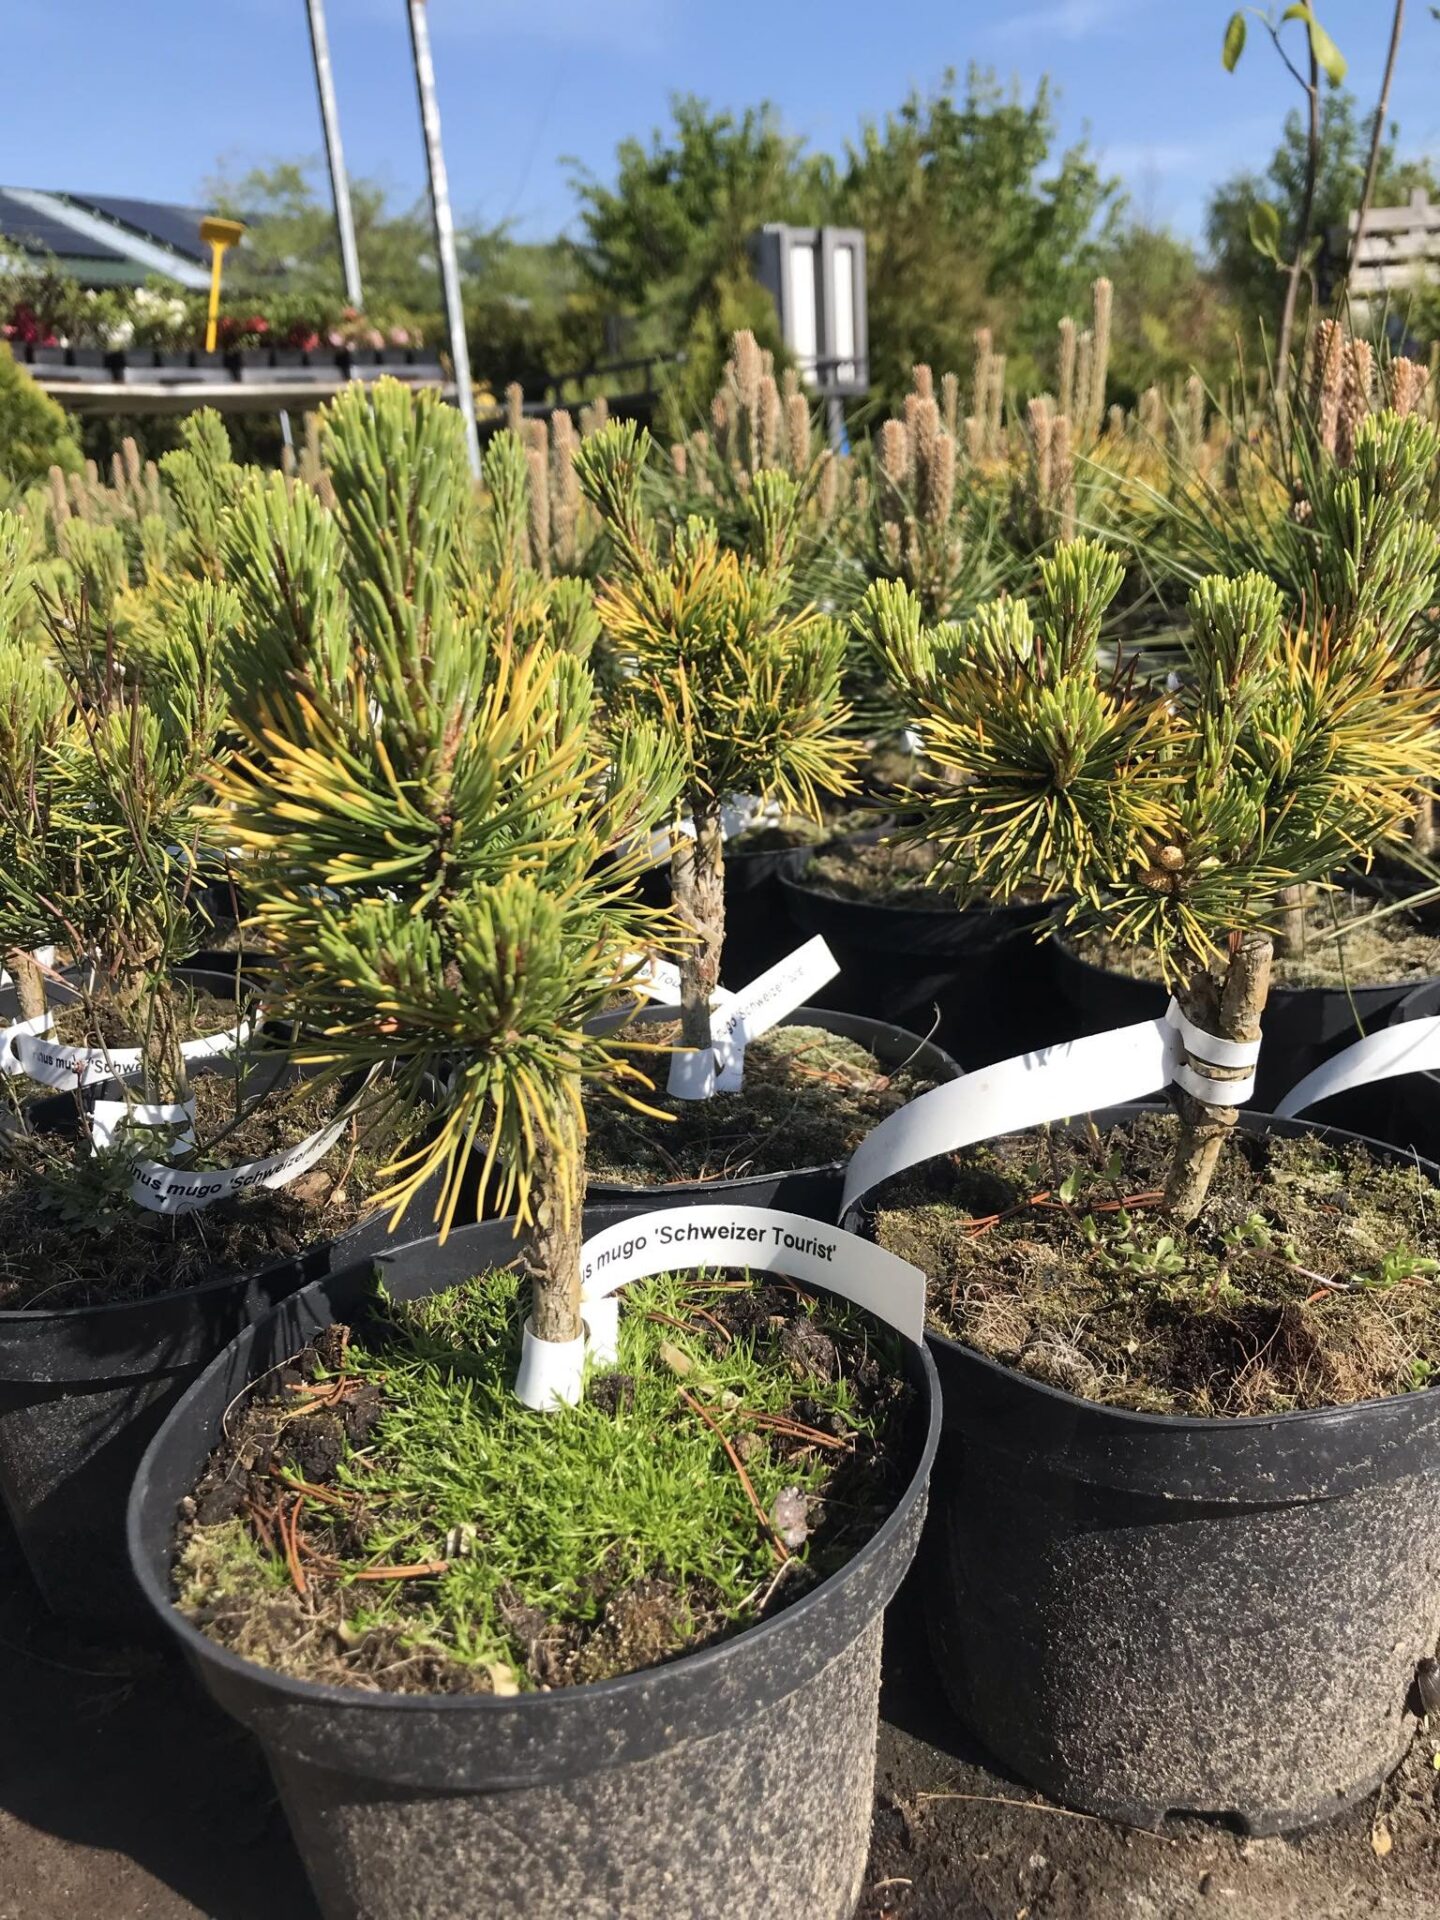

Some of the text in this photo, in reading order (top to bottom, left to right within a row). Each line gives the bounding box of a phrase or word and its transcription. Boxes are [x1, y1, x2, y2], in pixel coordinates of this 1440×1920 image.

[129, 1161, 162, 1190] inus
[166, 1182, 222, 1199] mugo
[597, 1236, 647, 1271] mugo
[654, 1222, 767, 1245] 'Schweizer
[771, 1226, 837, 1262] Tourist'
